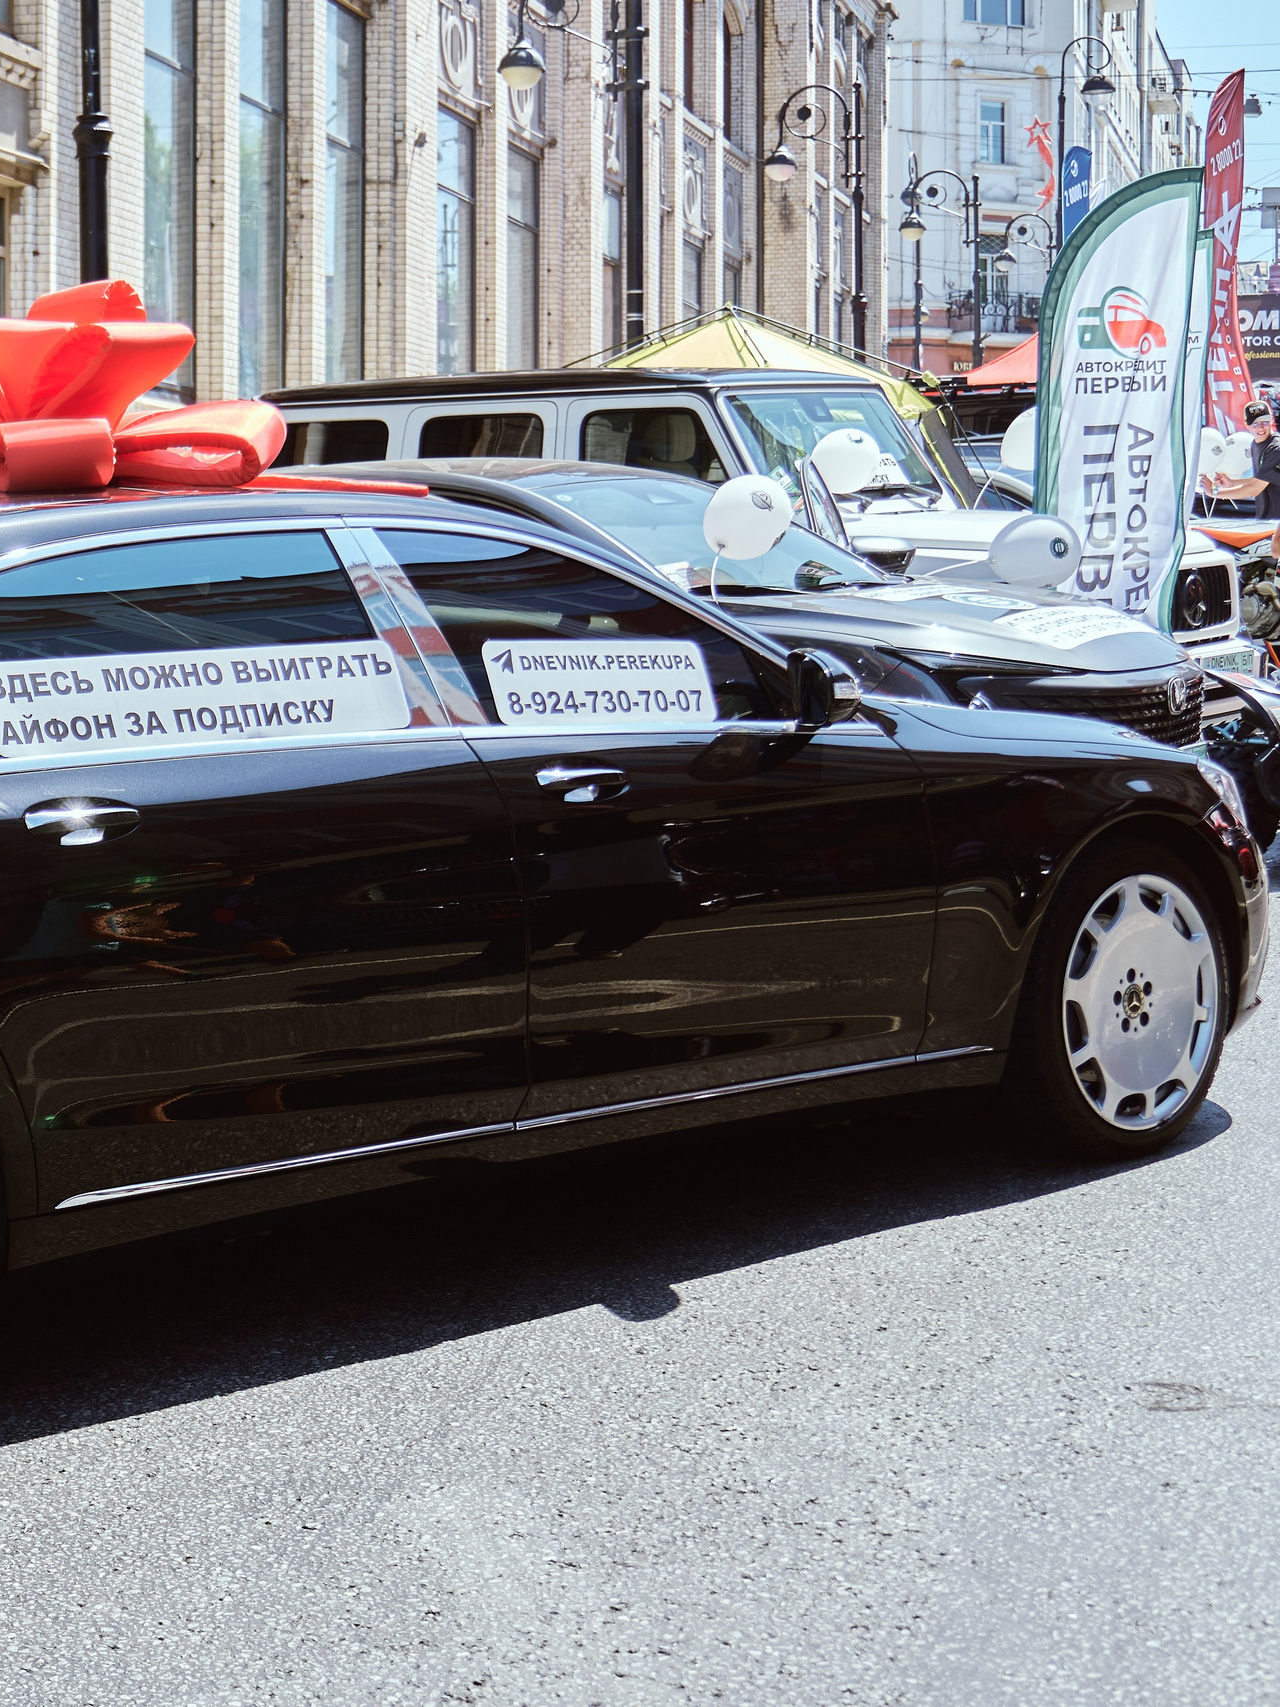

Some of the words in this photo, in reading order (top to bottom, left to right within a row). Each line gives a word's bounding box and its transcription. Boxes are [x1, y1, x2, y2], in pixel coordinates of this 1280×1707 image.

[1210, 157, 1218, 177] 2
[1215, 145, 1233, 172] 8000
[1232, 138, 1244, 161] 22
[1075, 360, 1167, 373] АВТОКРЕДИТ
[1075, 371, 1167, 394] ПЕРВЫЙ
[1076, 424, 1120, 606] ПЕРВ
[101, 660, 222, 694] МОЖНО
[230, 653, 393, 684] ВЫИГРАТЬ
[519, 654, 696, 671] DNEVNIK.PEREKUPA
[1211, 655, 1239, 669] DNEVNIK.
[506, 689, 703, 716] 8-924-730-70-07
[1, 713, 117, 746] АЙФОН
[126, 711, 168, 737] ЗА
[172, 698, 335, 735] ПОДПИСКУ
